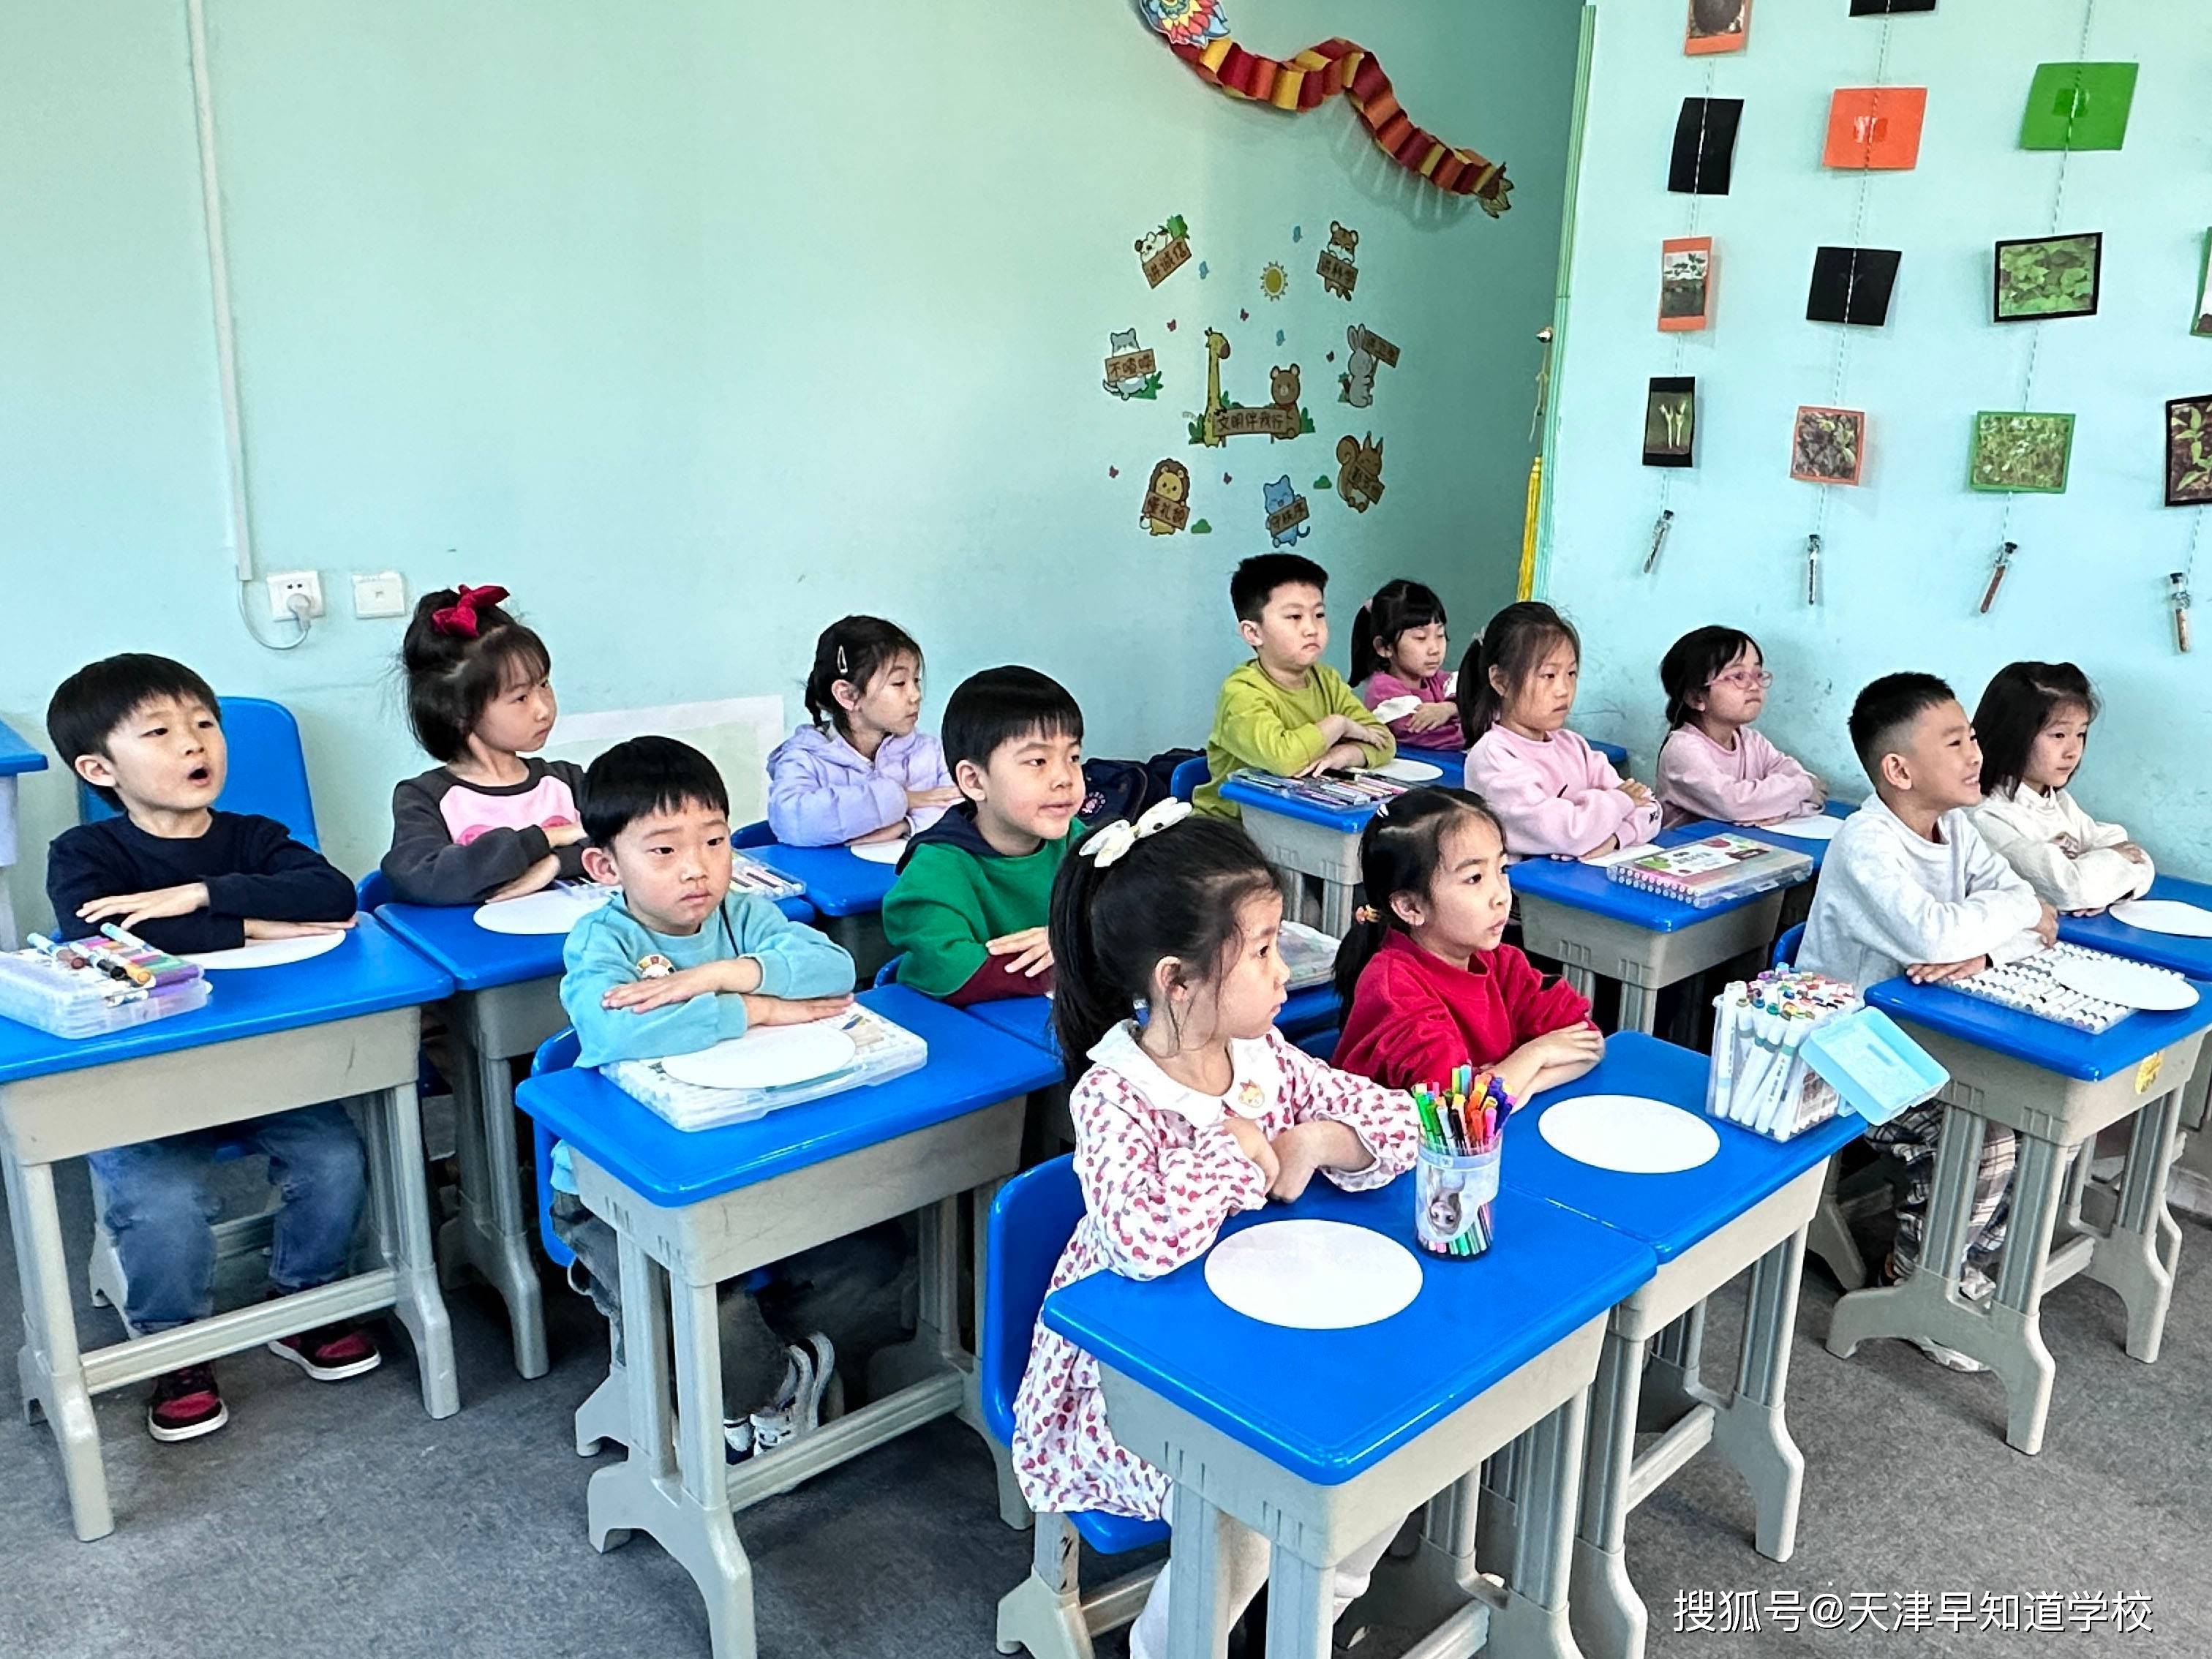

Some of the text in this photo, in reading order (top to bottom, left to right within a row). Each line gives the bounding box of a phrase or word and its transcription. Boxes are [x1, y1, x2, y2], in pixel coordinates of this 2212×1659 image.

[1217, 411, 1284, 431] 文明伴我行
